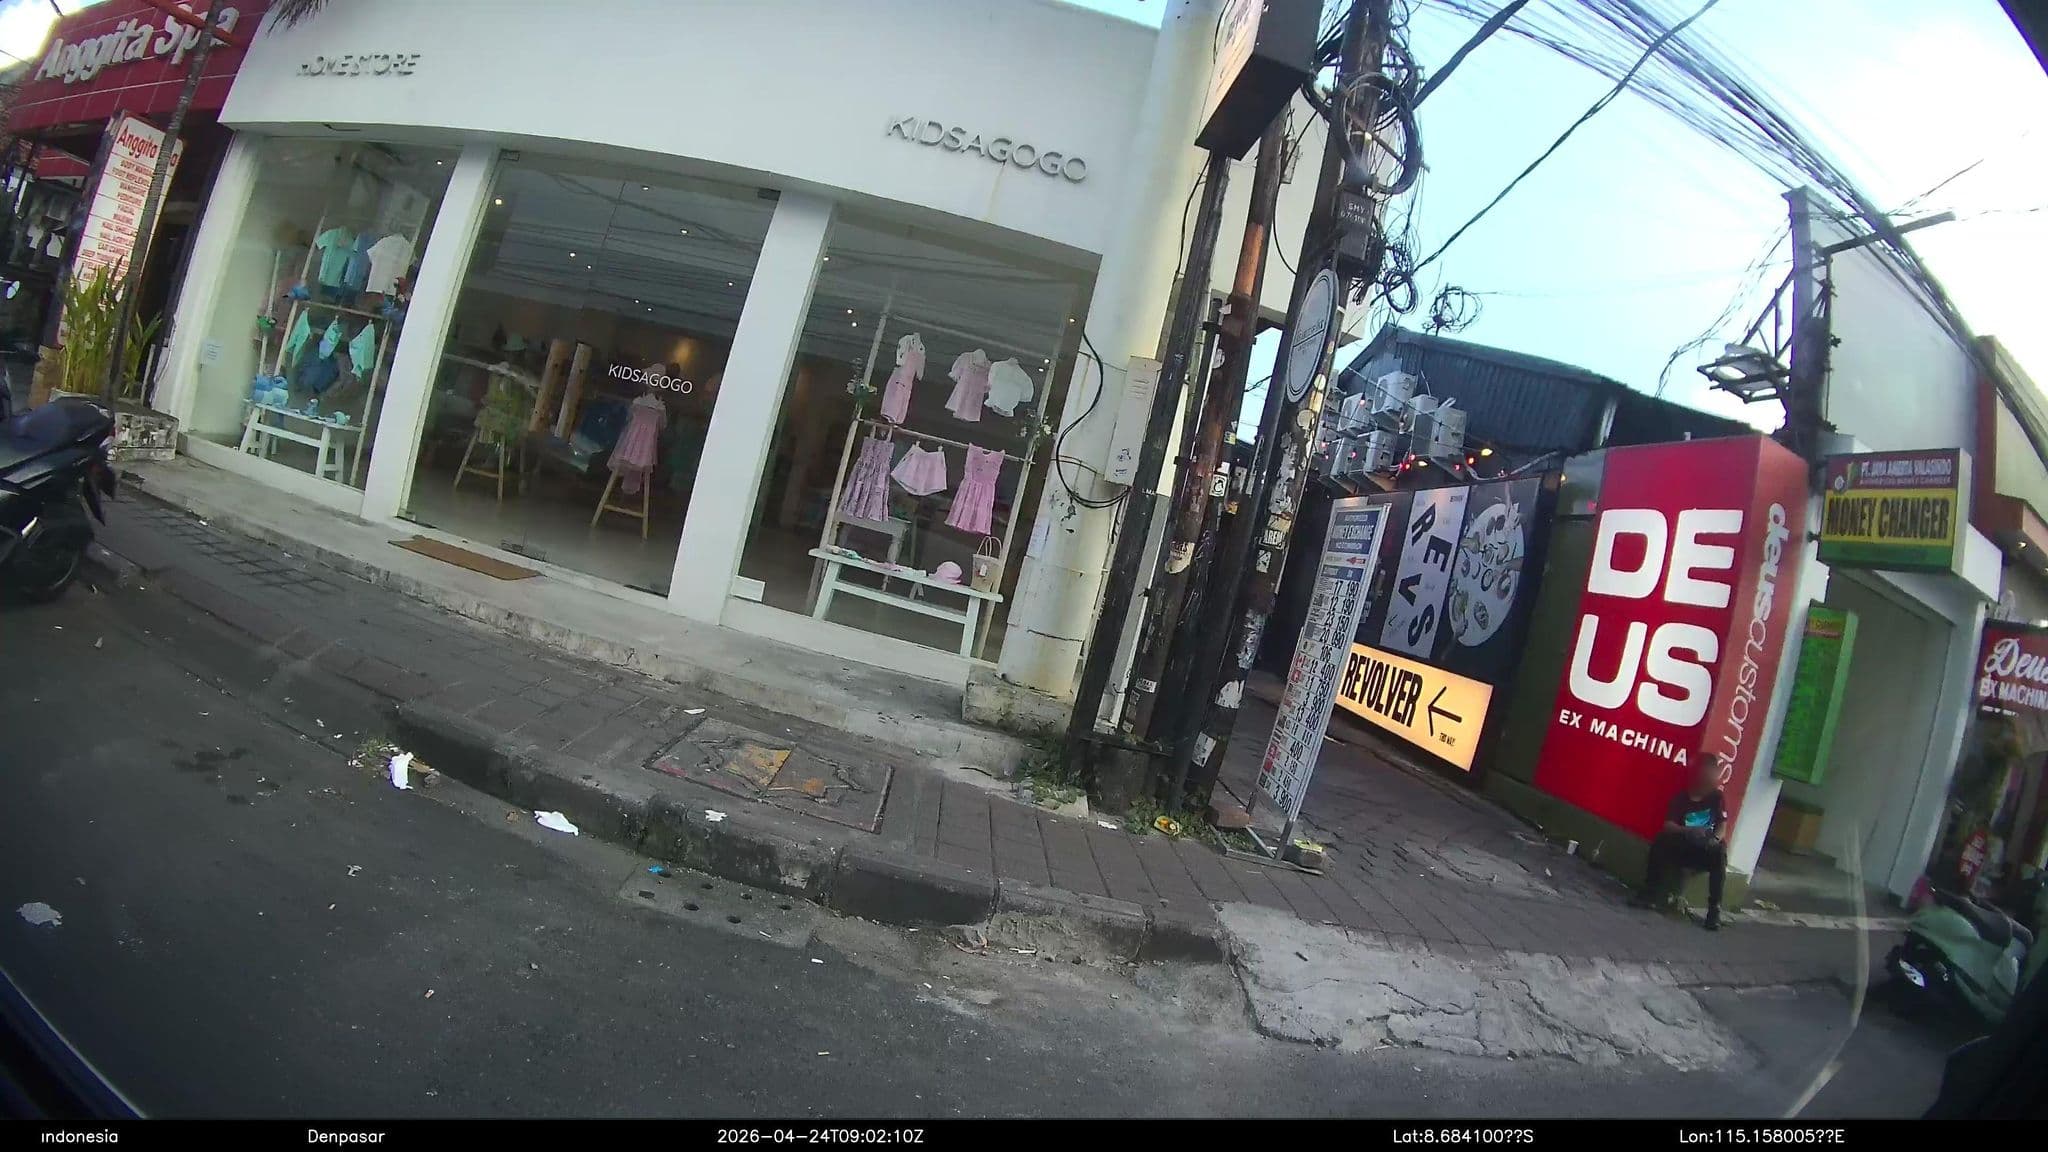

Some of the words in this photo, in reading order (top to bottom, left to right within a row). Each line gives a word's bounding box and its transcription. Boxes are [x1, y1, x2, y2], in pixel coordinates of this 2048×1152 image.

[34, 19, 154, 84] Anggita
[117, 124, 158, 159] Anggita
[886, 116, 1088, 183] KIDSAGOGO
[608, 363, 693, 394] KIDSAGOGO
[1826, 496, 1877, 536] MONEY
[1879, 496, 1950, 539] CHANGER
[1587, 508, 1744, 608] DE
[1340, 653, 1423, 728] REVOLVER
[1568, 613, 1719, 727] US
[1559, 708, 1583, 729] EX
[1589, 718, 1688, 767] MACHINA
